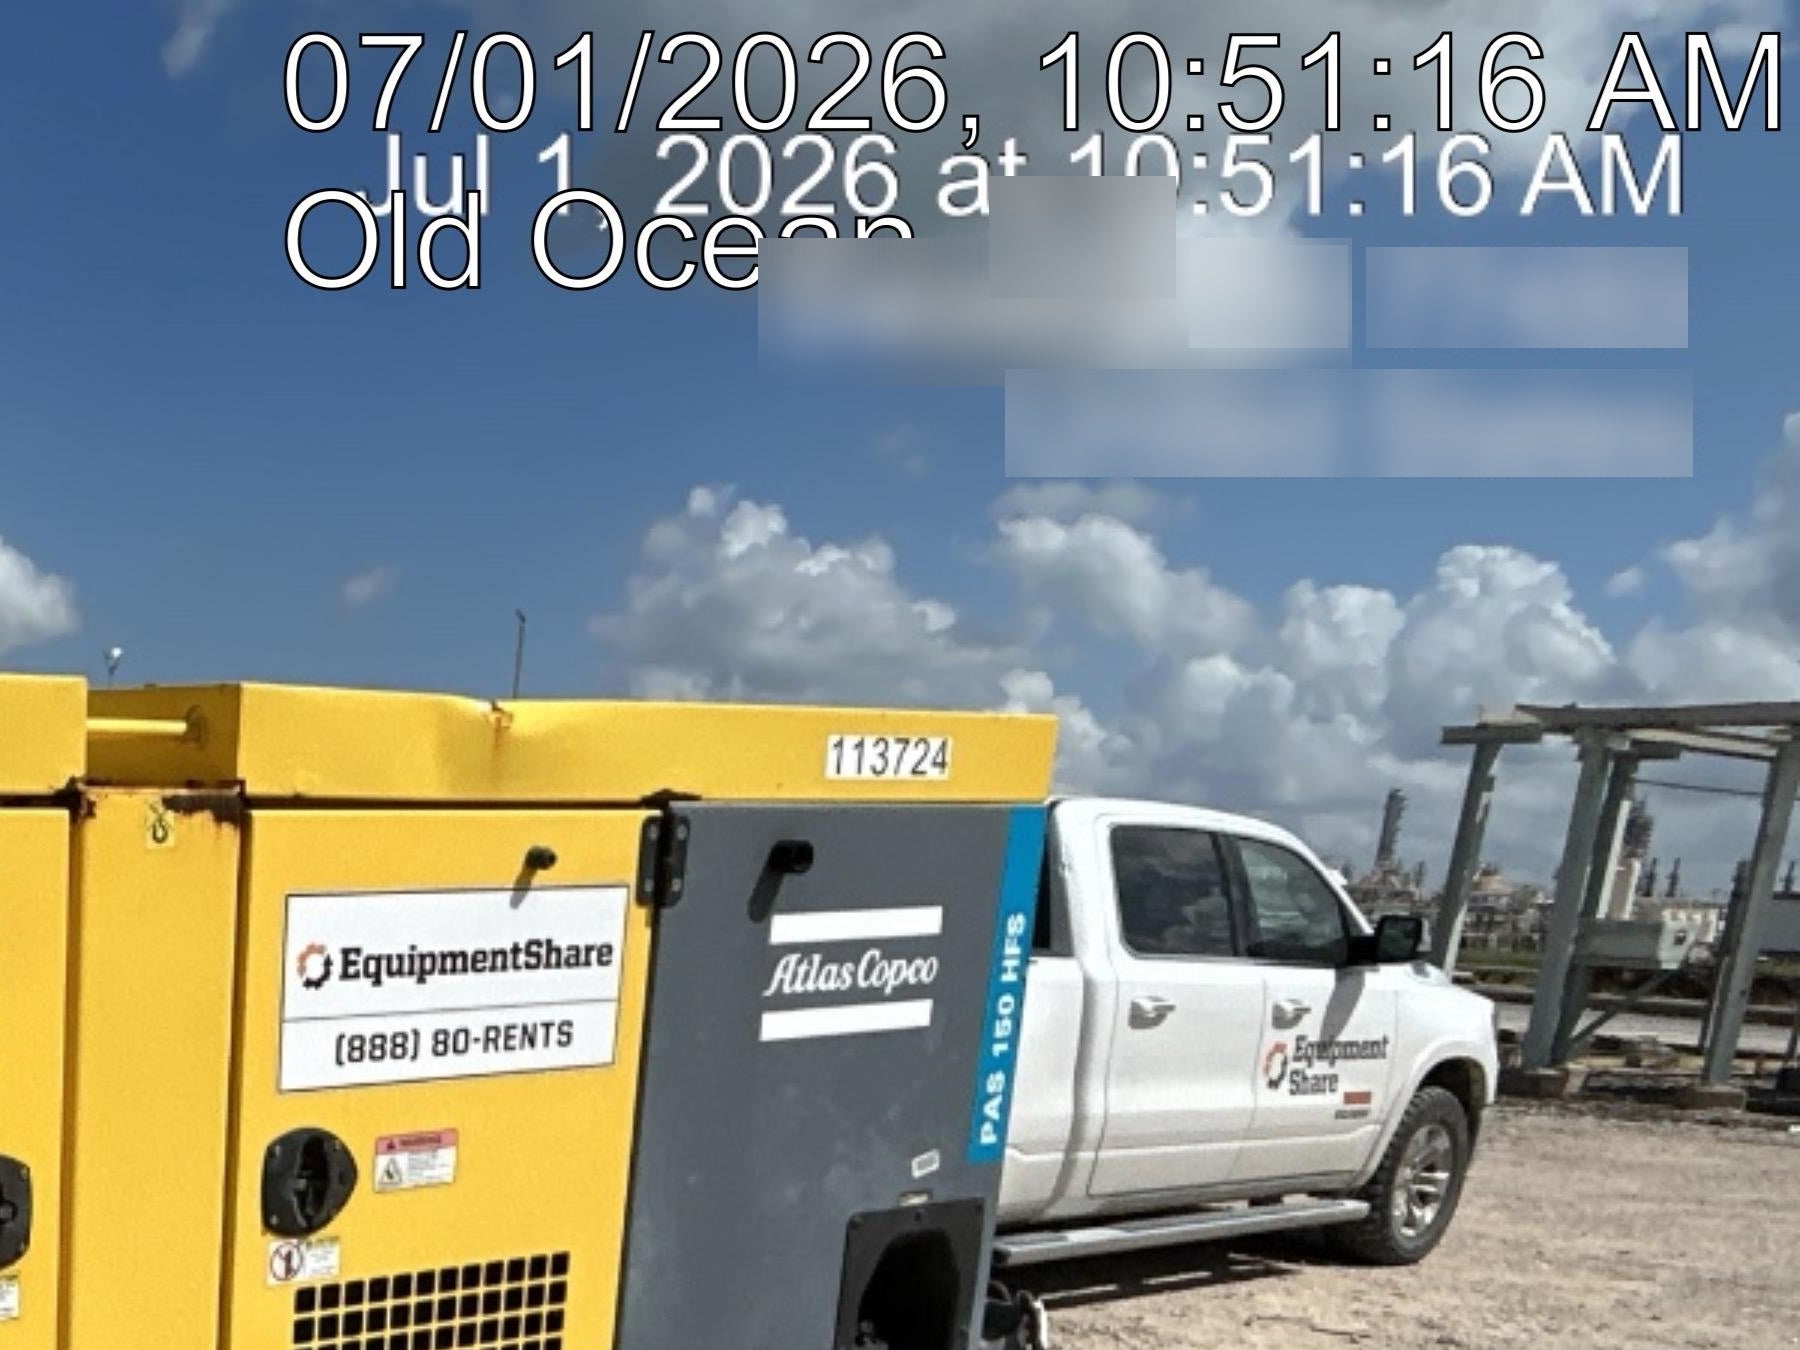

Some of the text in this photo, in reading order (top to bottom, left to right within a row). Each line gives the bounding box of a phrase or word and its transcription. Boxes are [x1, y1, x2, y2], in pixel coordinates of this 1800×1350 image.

[833, 736, 949, 776] 113724
[338, 937, 613, 988] EquipmentShare
[761, 947, 939, 997] Atlas Copco
[335, 1019, 574, 1066] (888) 80-RENTS
[979, 912, 1027, 1144] PAS 150 HFS
[1292, 1034, 1389, 1068] Equipment
[1289, 1068, 1339, 1096] Share
